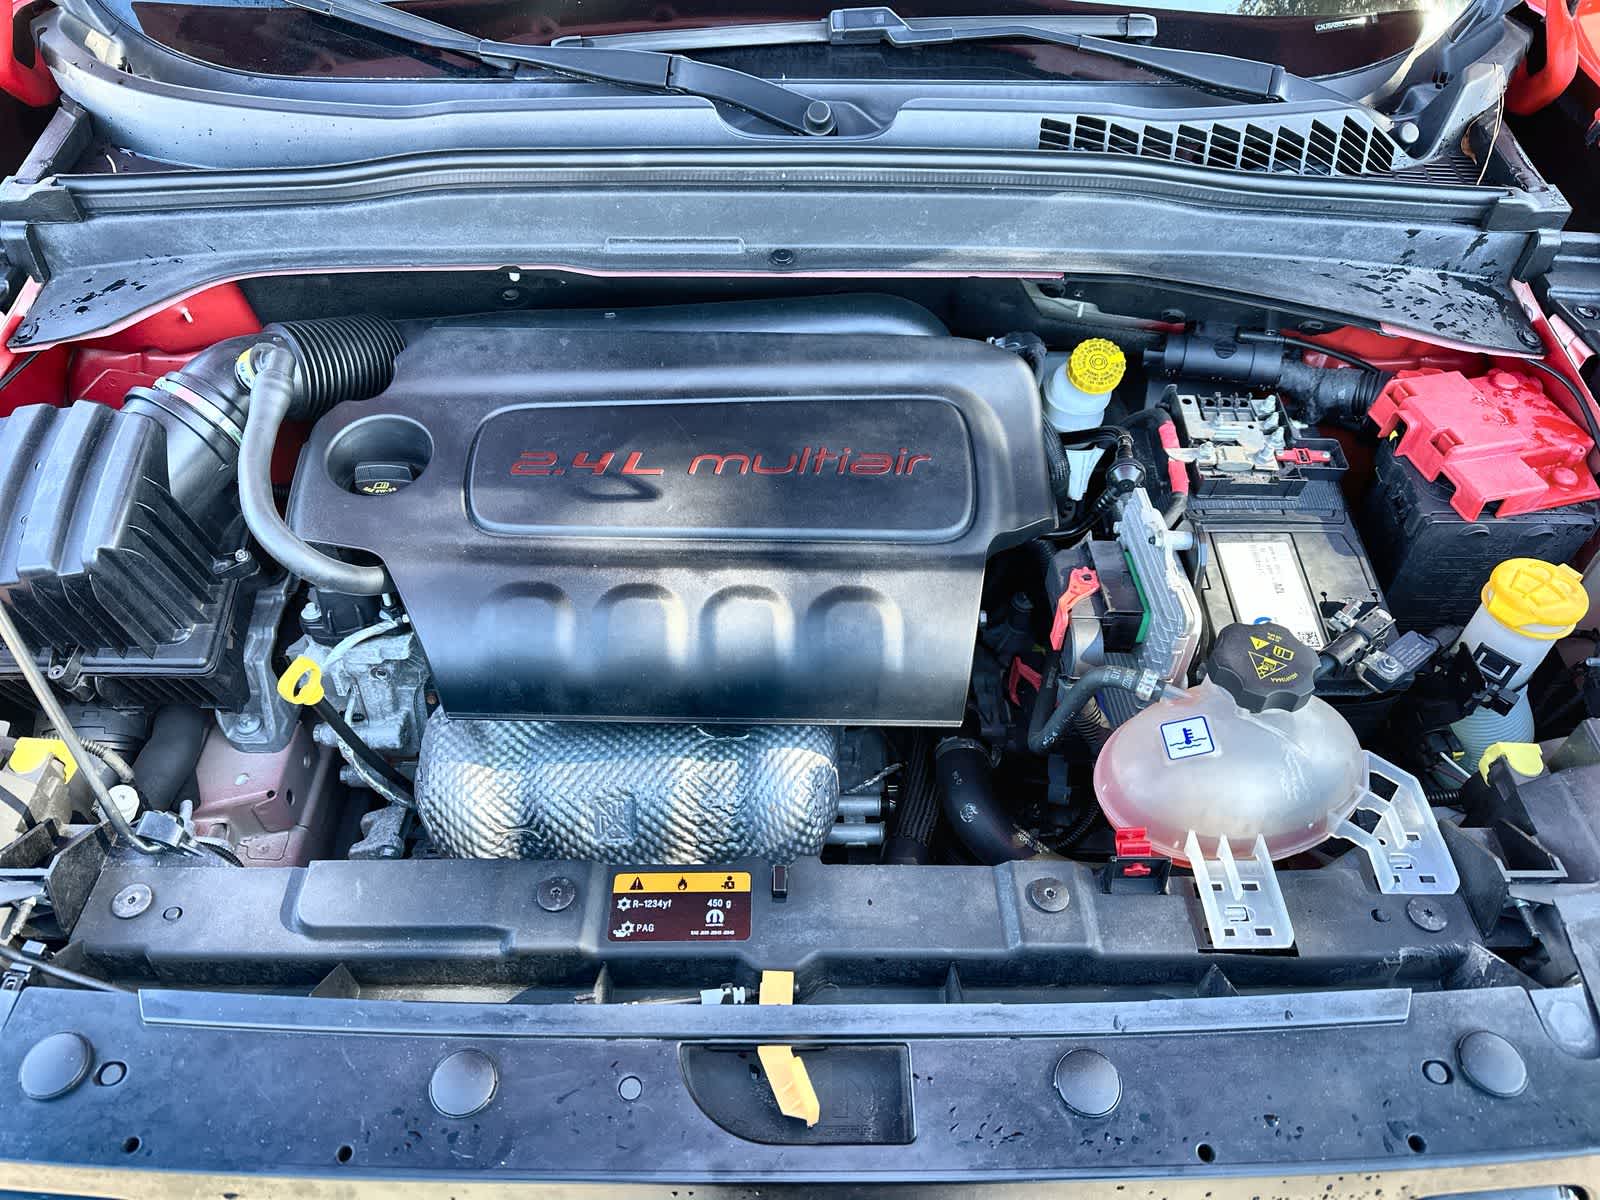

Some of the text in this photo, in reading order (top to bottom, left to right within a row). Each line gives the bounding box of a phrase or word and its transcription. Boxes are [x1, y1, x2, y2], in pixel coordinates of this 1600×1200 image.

[510, 447, 933, 476] 2.4L multiair
[706, 898, 732, 909] 450 g
[636, 923, 655, 933] PAG
